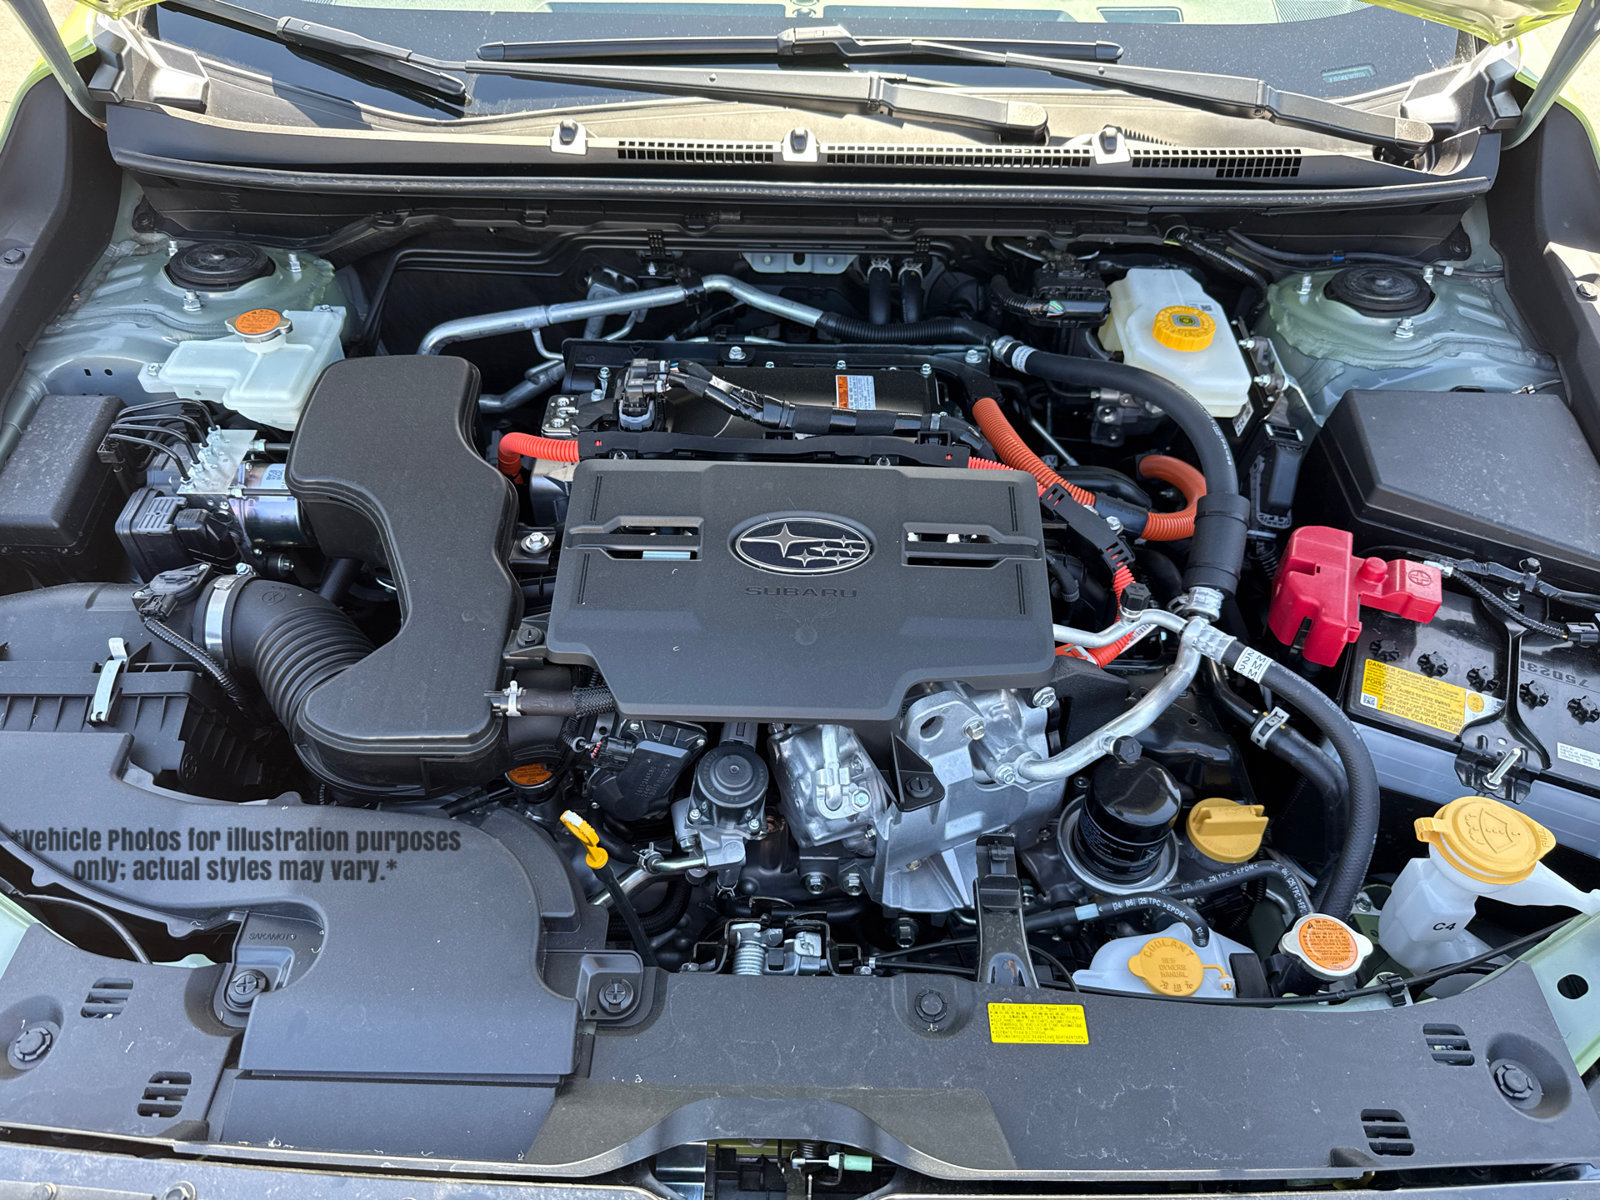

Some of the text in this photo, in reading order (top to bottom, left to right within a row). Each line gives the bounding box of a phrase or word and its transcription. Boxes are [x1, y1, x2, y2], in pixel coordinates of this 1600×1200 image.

[744, 586, 857, 598] SUBARU
[1366, 660, 1396, 673] DANGER
[1364, 677, 1393, 690] POISON
[1432, 922, 1457, 931] C4
[1143, 939, 1194, 958] COOLANT
